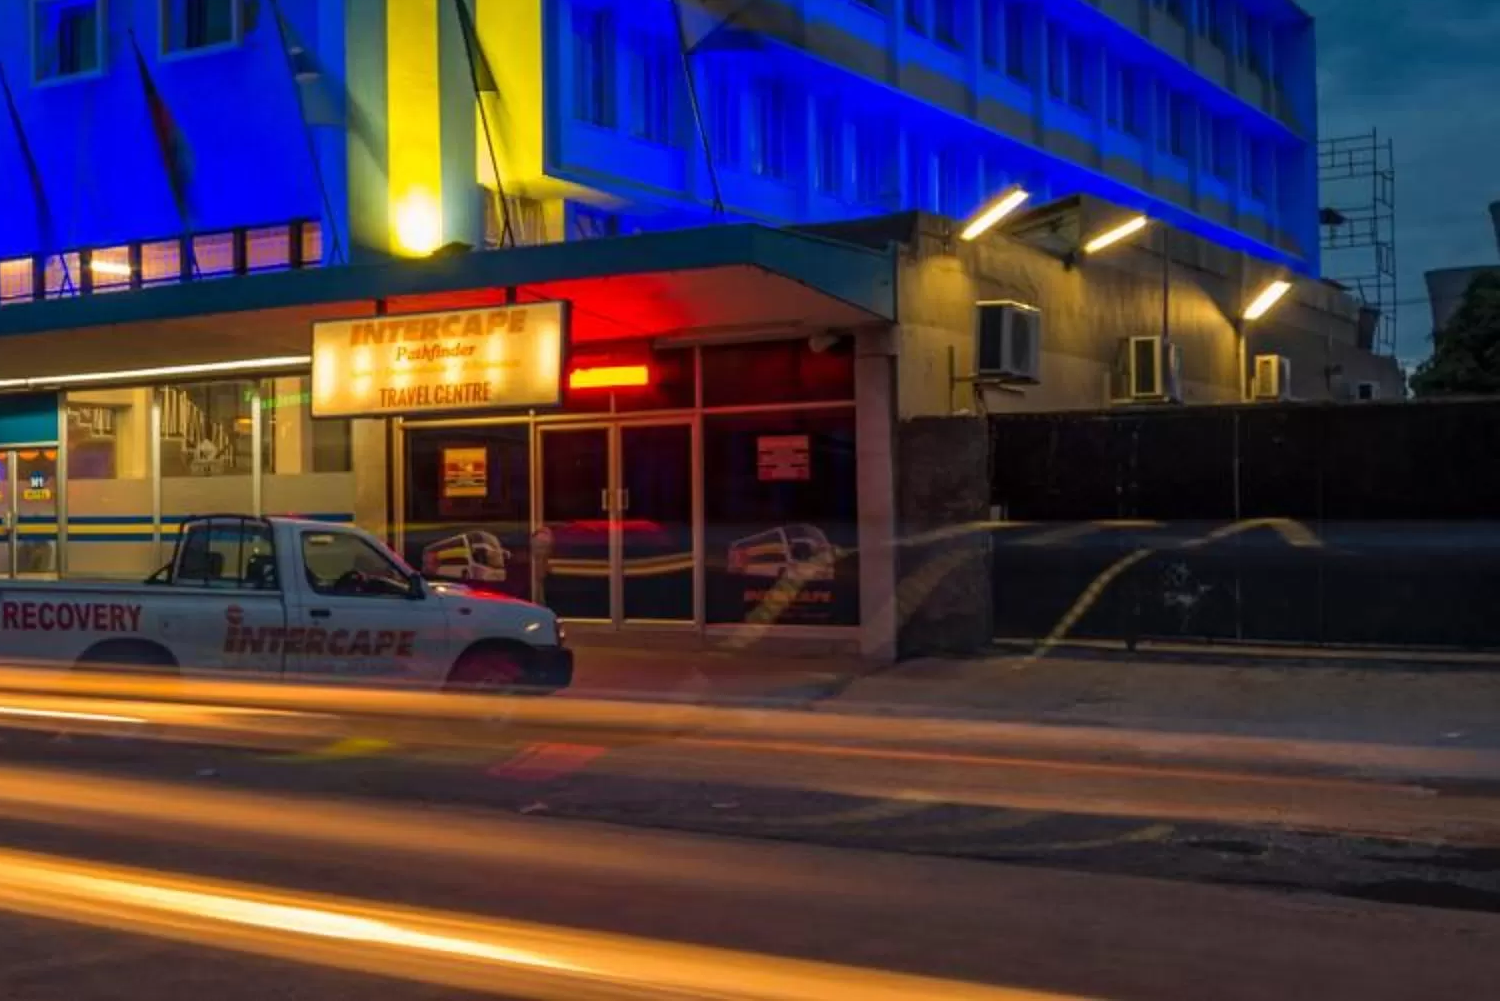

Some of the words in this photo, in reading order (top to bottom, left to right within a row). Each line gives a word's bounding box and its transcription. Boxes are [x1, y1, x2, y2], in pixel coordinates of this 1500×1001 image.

[350, 309, 528, 346] INTERCAPE
[395, 342, 476, 362] Pathfinder
[379, 385, 431, 408] TRAVEL
[433, 381, 491, 403] CENTRE
[2, 601, 142, 632] RECOVERY
[224, 625, 417, 657] INTERCAPE
